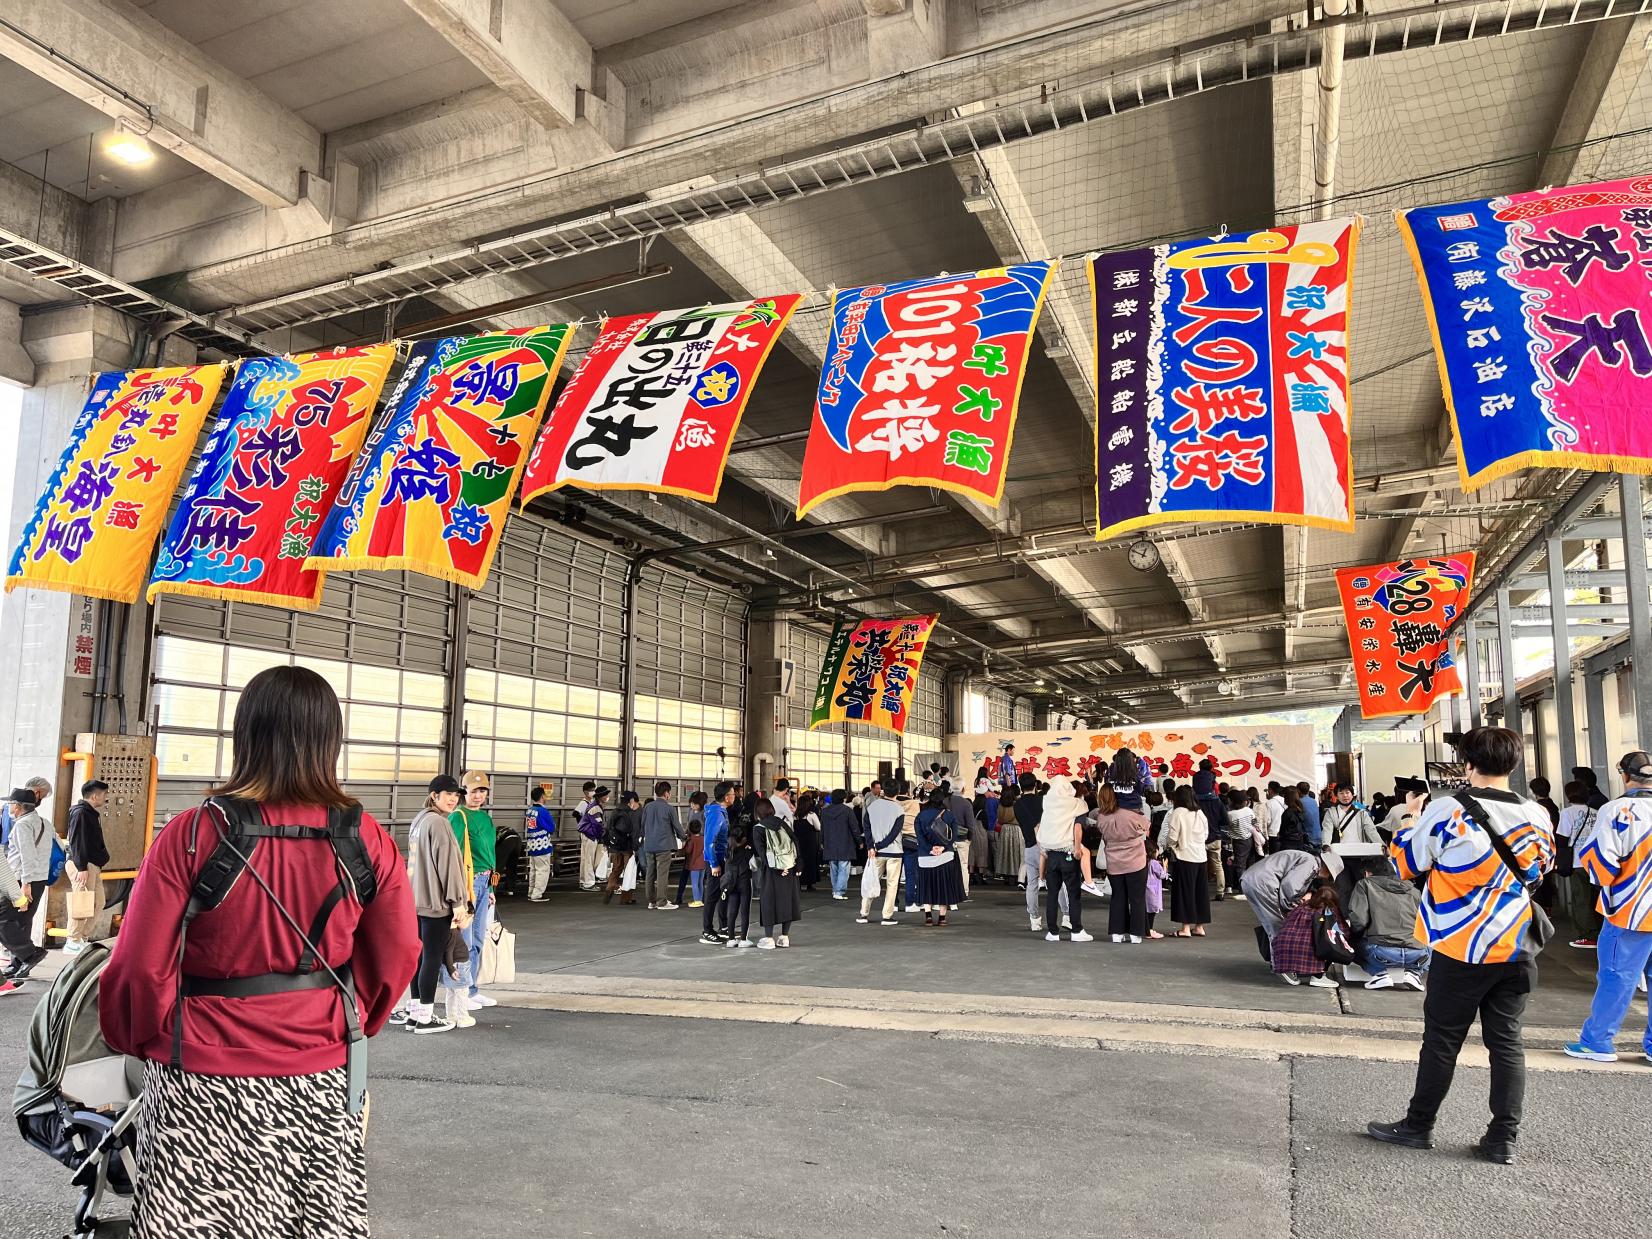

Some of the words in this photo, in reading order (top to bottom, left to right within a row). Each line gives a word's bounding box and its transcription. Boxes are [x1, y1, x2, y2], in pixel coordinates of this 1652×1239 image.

[566, 316, 718, 471] 日の出丸
[1169, 265, 1268, 491] 二人の美桜
[278, 474, 328, 560] 祝大漁
[785, 662, 794, 694] 7
